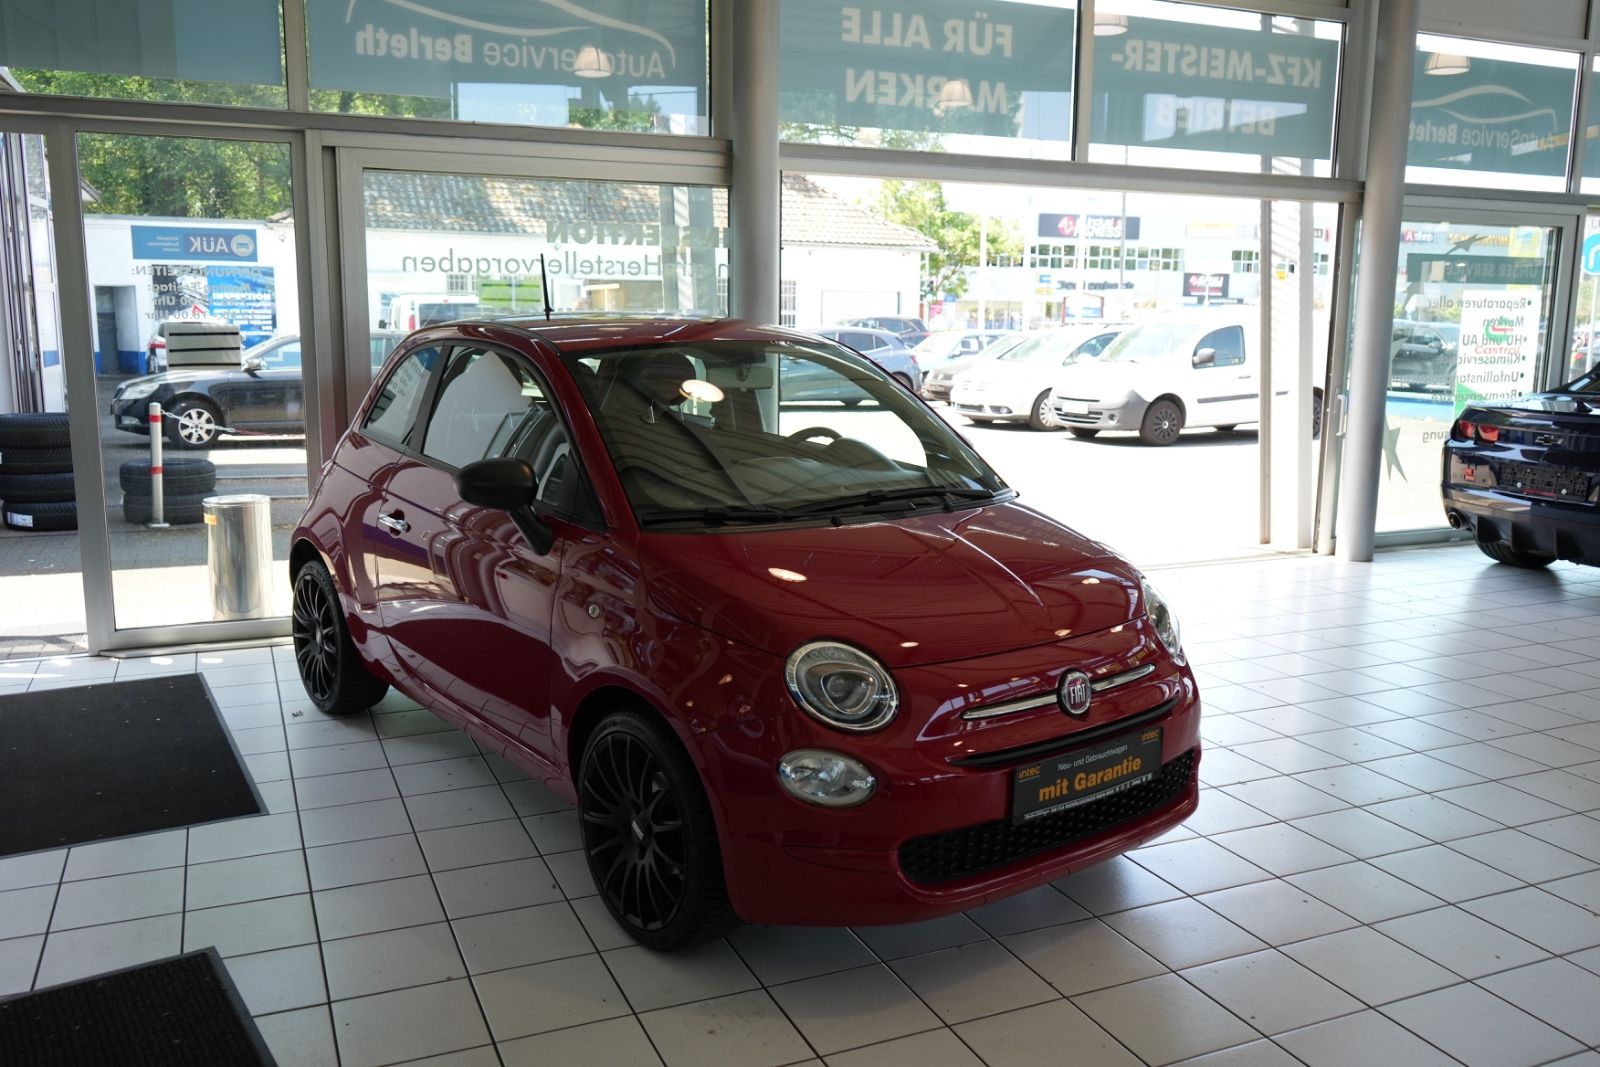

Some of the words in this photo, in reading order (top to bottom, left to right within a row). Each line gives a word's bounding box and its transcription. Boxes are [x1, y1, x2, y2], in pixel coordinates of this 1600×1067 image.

[1474, 345, 1520, 355] Castrol
[1069, 682, 1087, 704] FIAT
[1073, 756, 1085, 767] und
[1085, 744, 1129, 763] Gebrauchtwagen
[1018, 765, 1041, 780] intec
[1038, 777, 1069, 802] mit
[1074, 755, 1142, 792] Garantie
